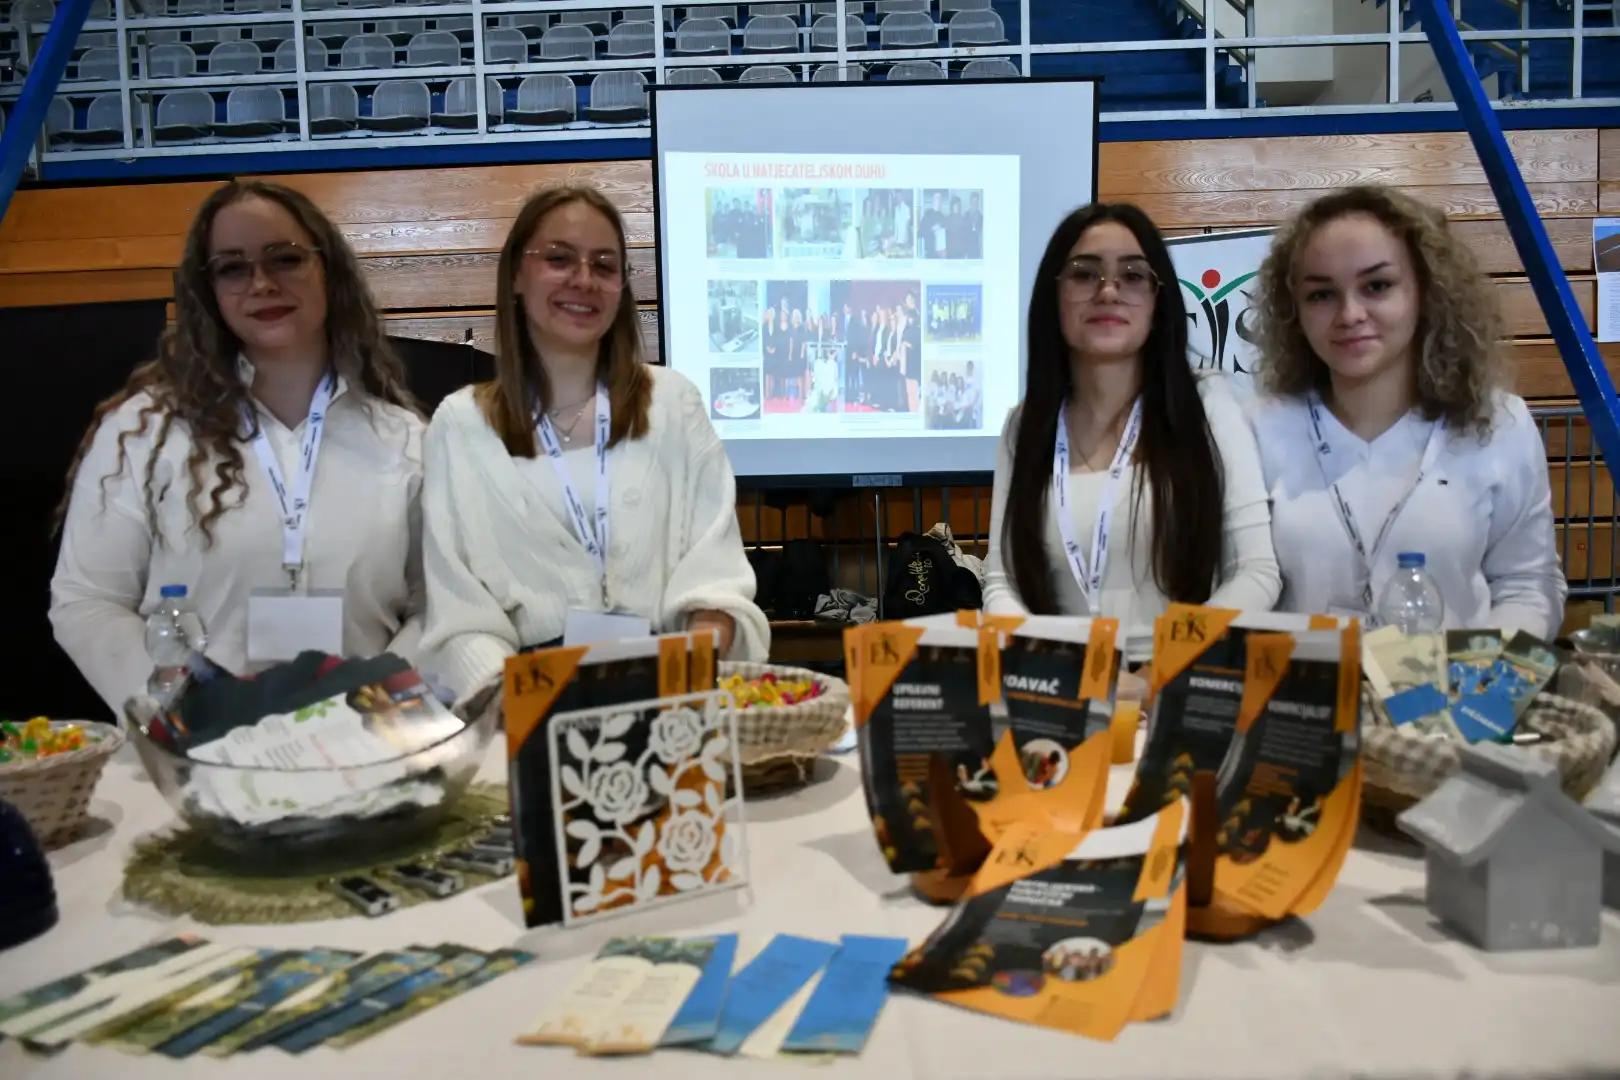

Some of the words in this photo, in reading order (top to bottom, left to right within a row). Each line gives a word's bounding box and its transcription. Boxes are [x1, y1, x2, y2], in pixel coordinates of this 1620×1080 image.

[742, 162, 750, 178] U
[753, 162, 852, 179] NATJECATELJSKOM
[855, 163, 886, 179] DUHU
